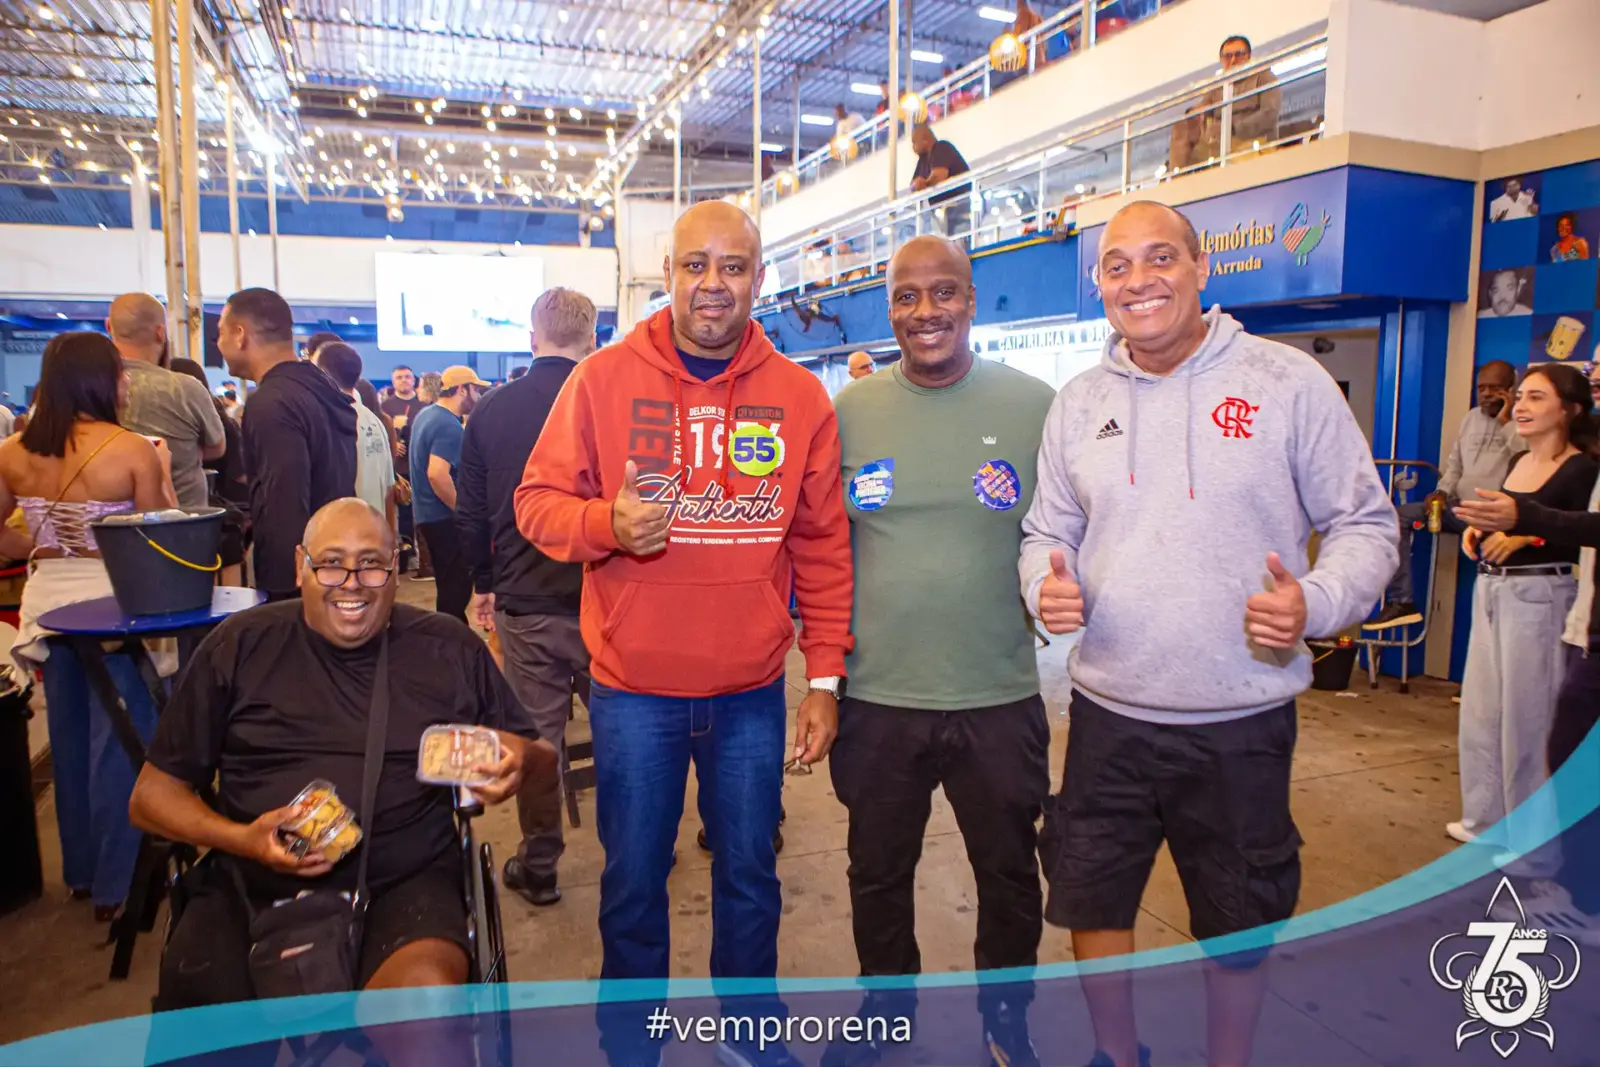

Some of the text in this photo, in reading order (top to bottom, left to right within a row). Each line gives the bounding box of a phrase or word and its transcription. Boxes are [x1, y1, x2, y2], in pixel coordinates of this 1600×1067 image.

[1213, 256, 1263, 276] Arruda
[689, 406, 717, 416] DELKOR
[736, 408, 782, 418] DIVISION
[1096, 429, 1123, 440] adidas
[734, 436, 775, 463] 55
